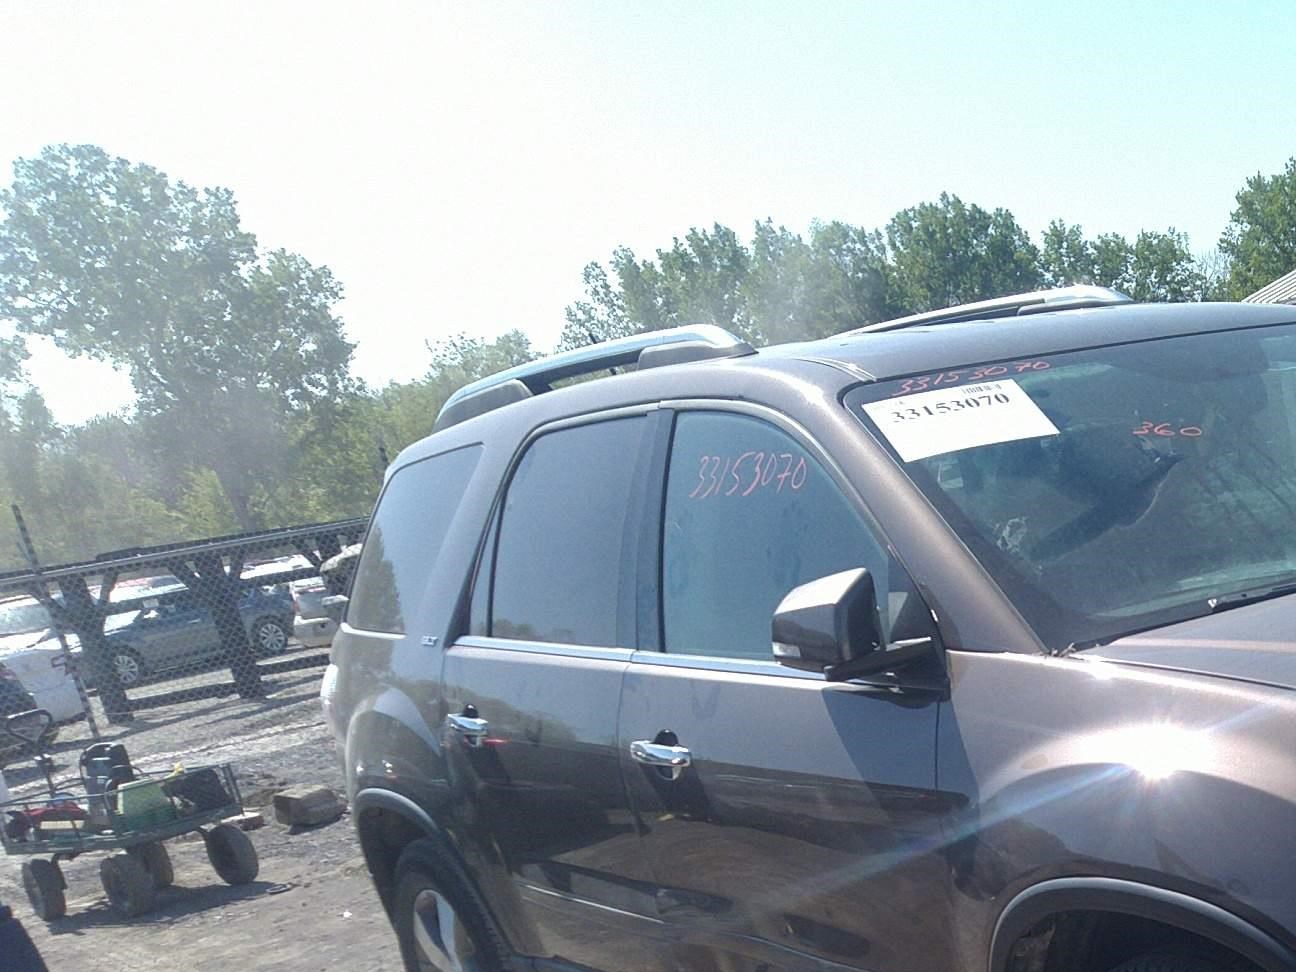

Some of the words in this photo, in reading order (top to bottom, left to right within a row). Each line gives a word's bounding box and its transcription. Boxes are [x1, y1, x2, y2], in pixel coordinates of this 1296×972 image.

[890, 393, 1011, 424] 33153070
[1132, 421, 1203, 437] 360
[688, 451, 807, 499] 33153070
